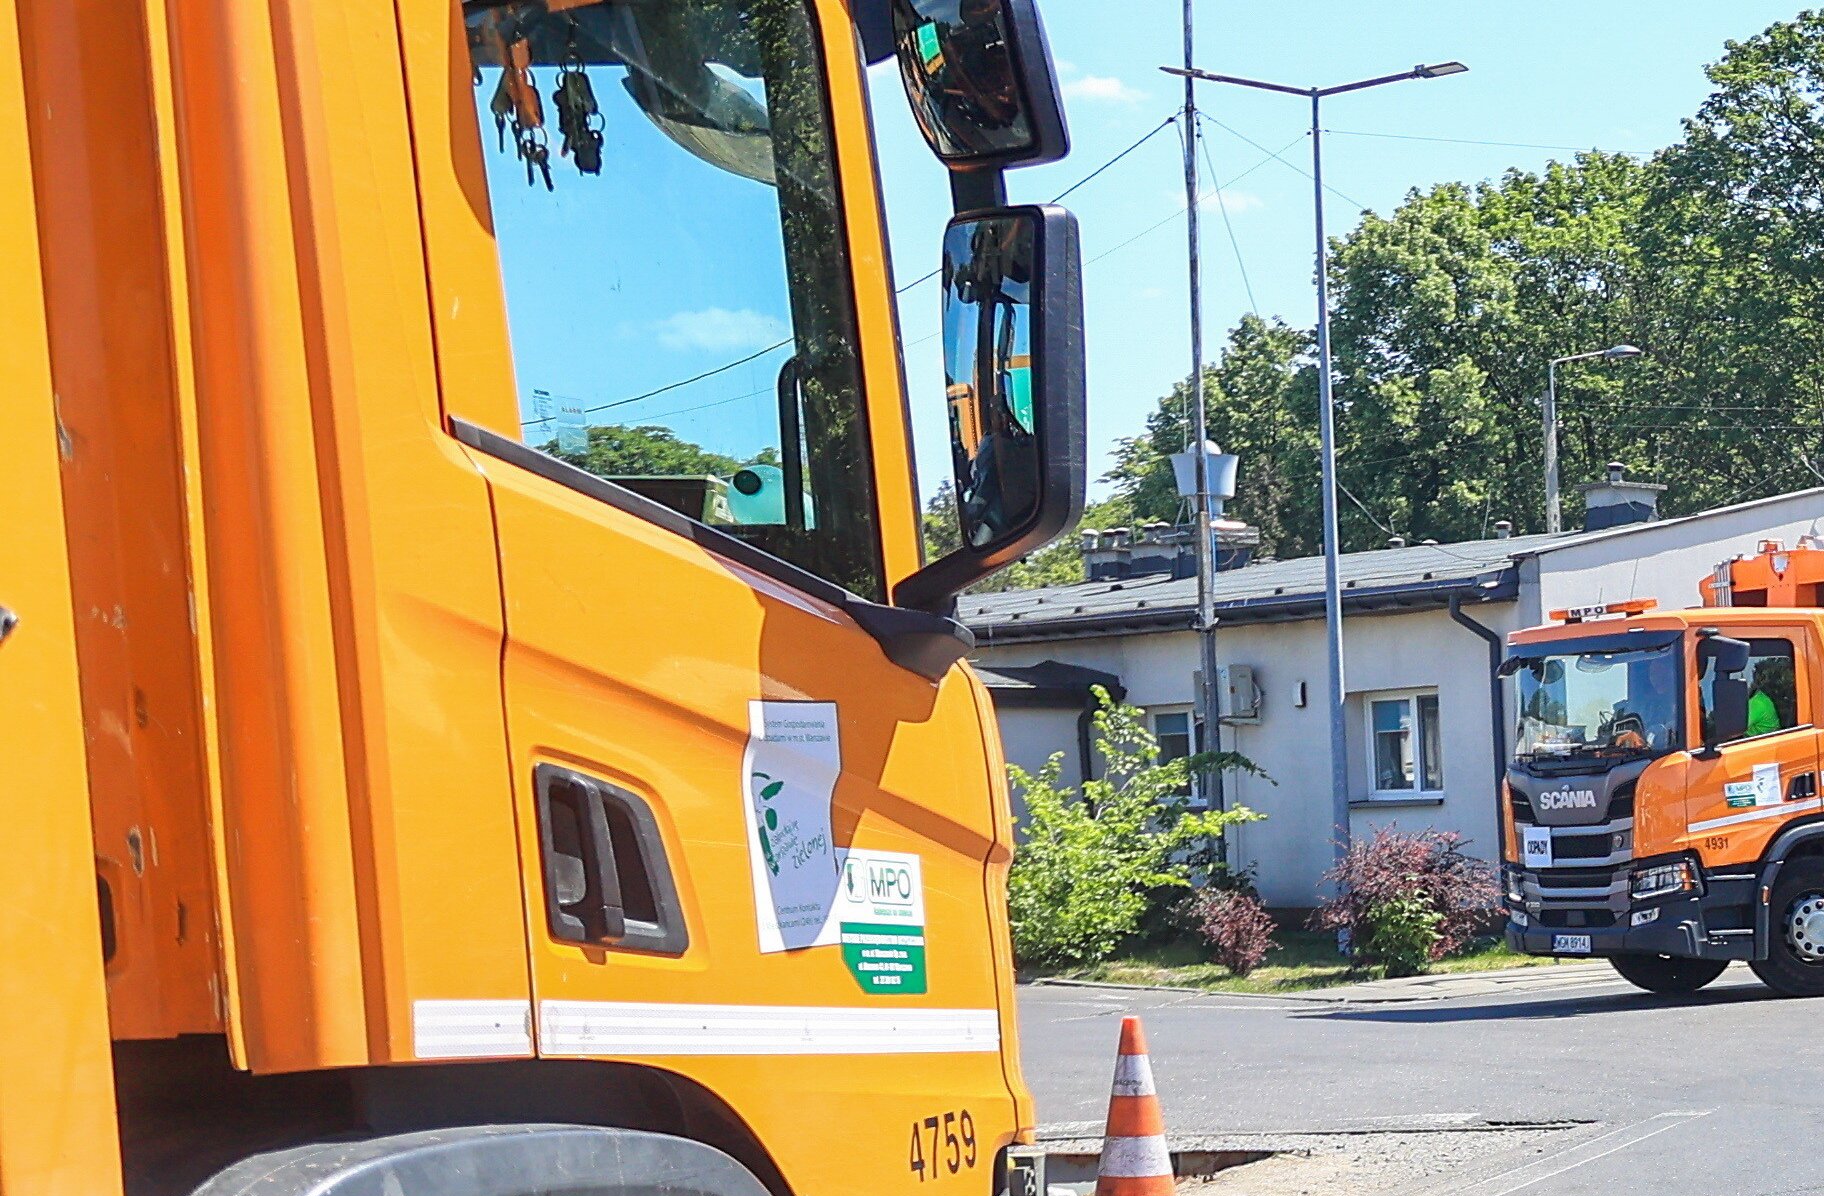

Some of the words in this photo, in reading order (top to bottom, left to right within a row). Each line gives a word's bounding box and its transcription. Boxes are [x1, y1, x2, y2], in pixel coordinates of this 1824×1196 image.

[1570, 605, 1604, 617] MPO
[1540, 790, 1596, 810] SCANIA
[1705, 837, 1729, 850] 4931
[869, 866, 911, 899] MPO
[910, 1109, 976, 1182] 4759
